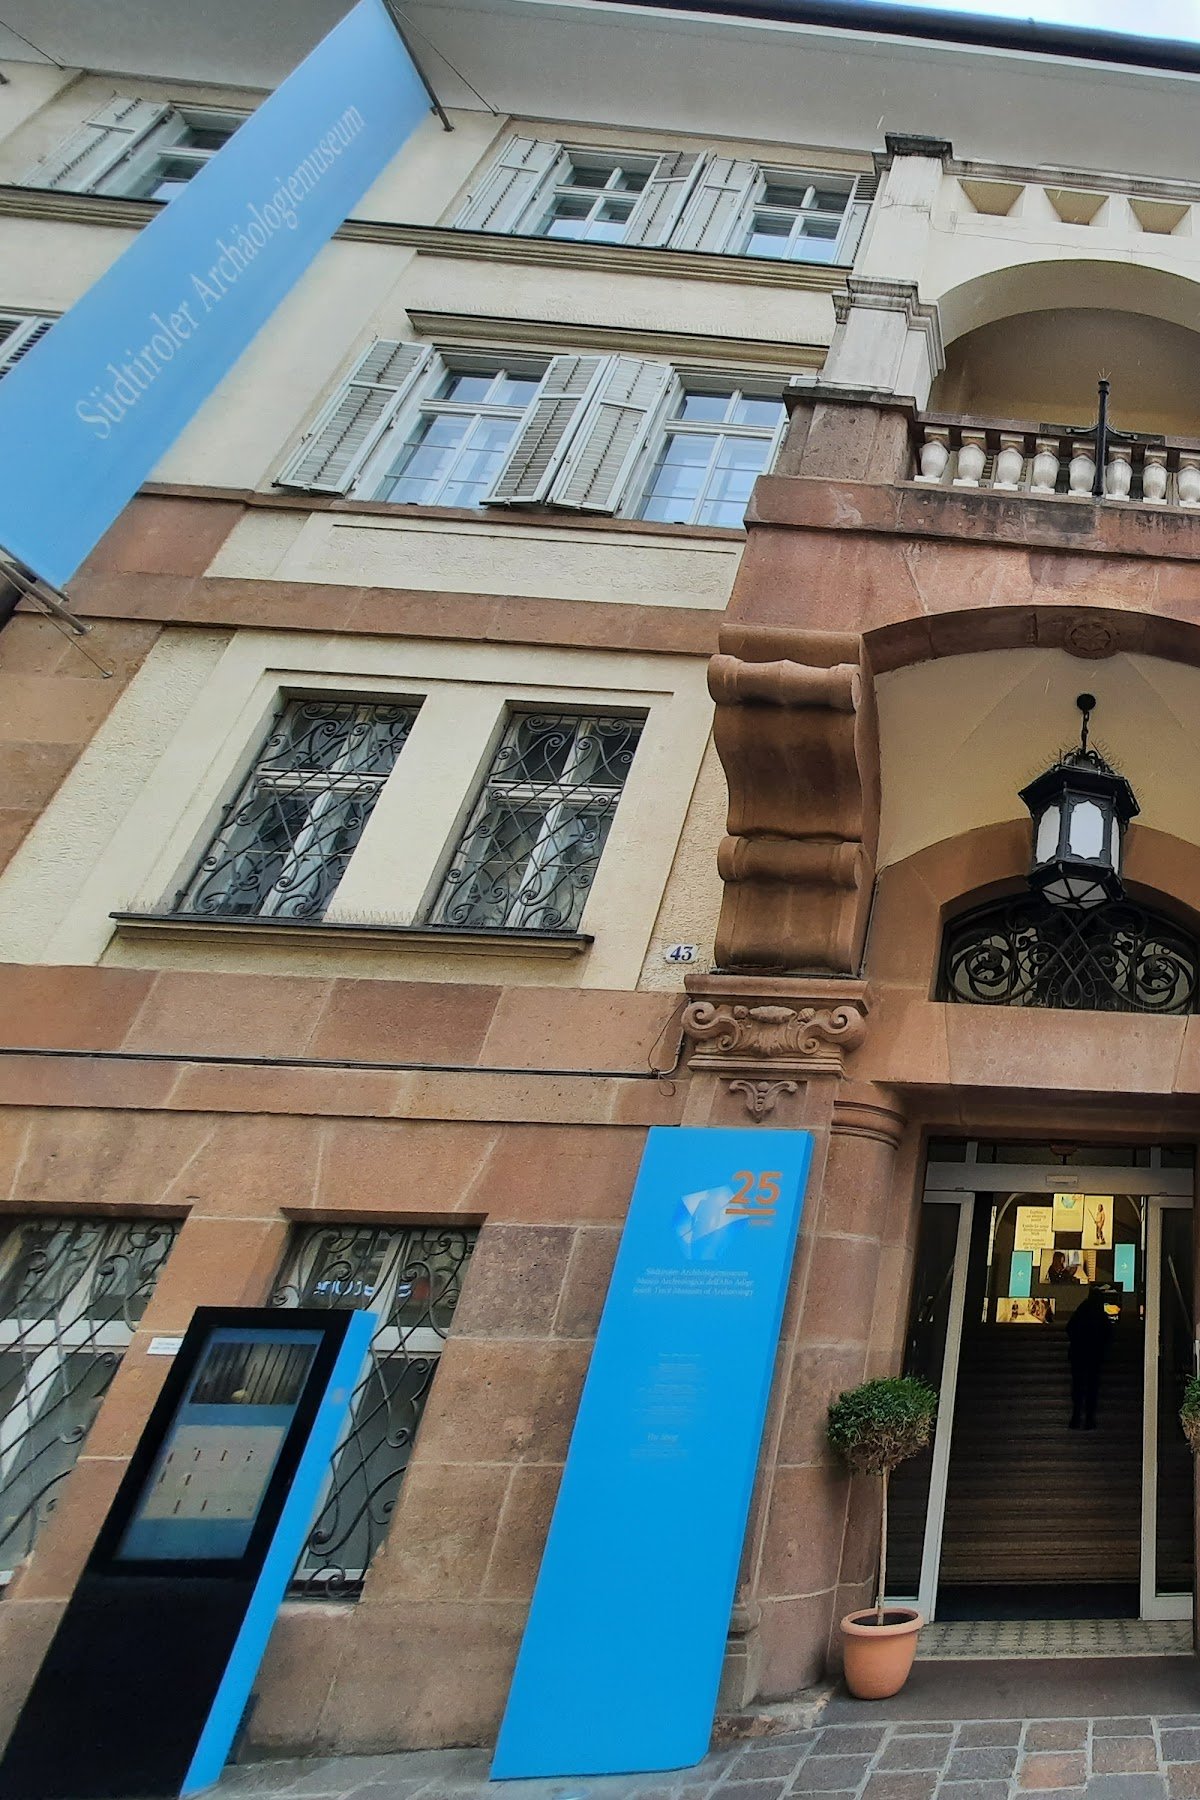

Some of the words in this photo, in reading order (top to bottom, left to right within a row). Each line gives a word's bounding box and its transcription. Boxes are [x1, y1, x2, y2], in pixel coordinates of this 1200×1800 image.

[76, 300, 199, 439] Südtiroler
[191, 104, 366, 313] Archäologiemuseum
[670, 946, 693, 961] 43
[730, 1170, 783, 1204] 25
